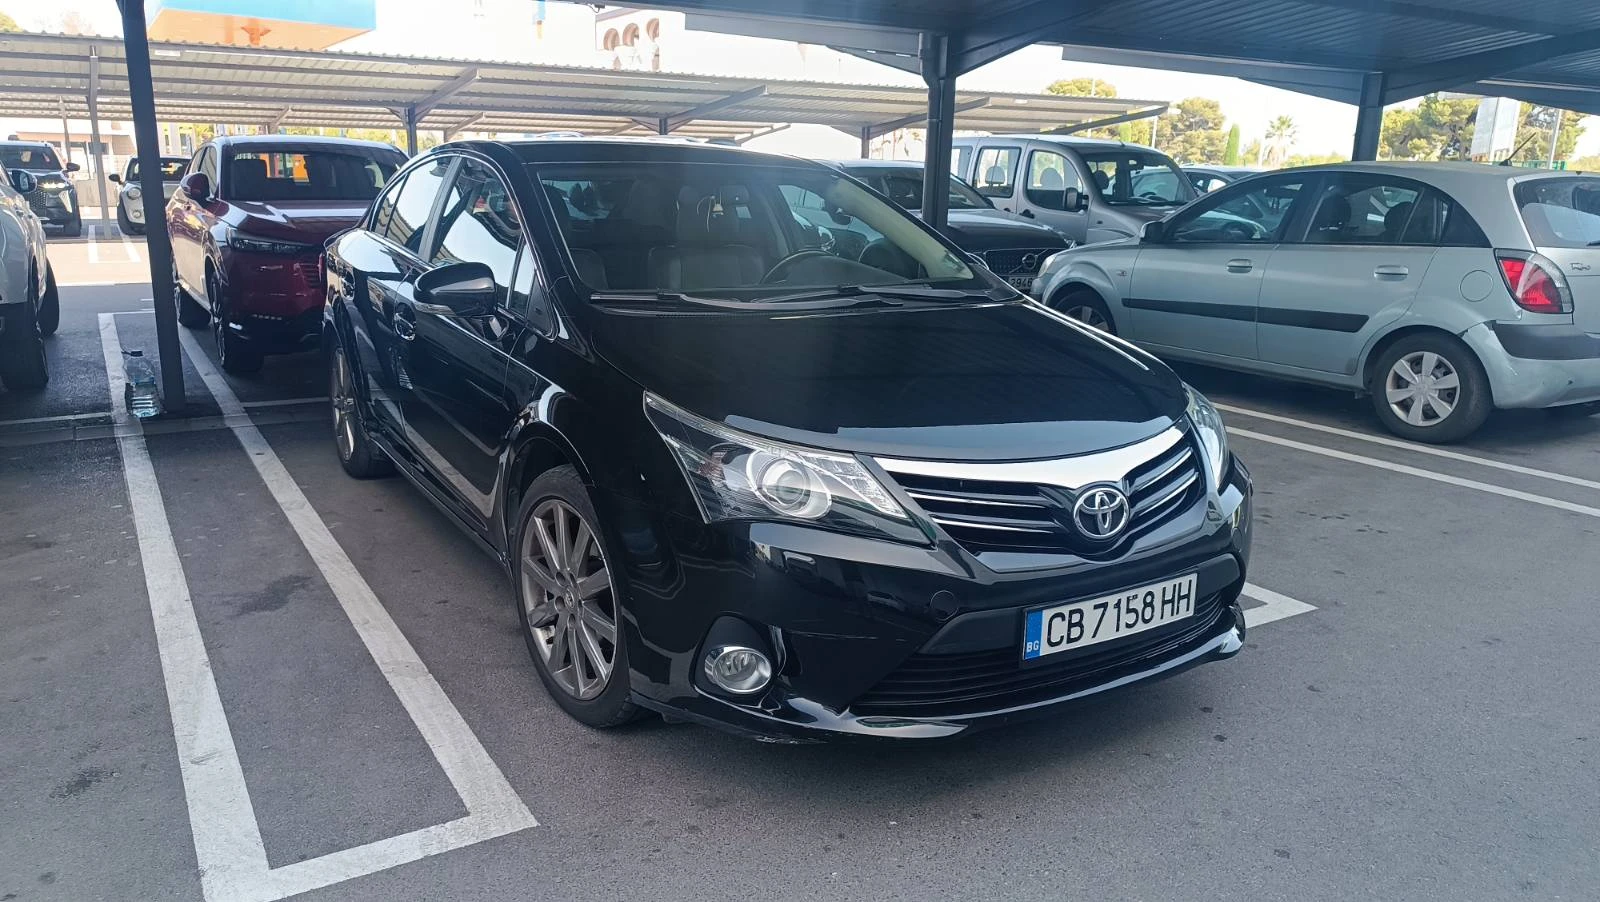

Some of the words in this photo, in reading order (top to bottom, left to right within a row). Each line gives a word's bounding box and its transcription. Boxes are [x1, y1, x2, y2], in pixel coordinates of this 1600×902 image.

[1046, 608, 1085, 648] CB
[1091, 590, 1155, 639] 7158
[1160, 579, 1193, 620] HH
[1026, 640, 1040, 653] BG
